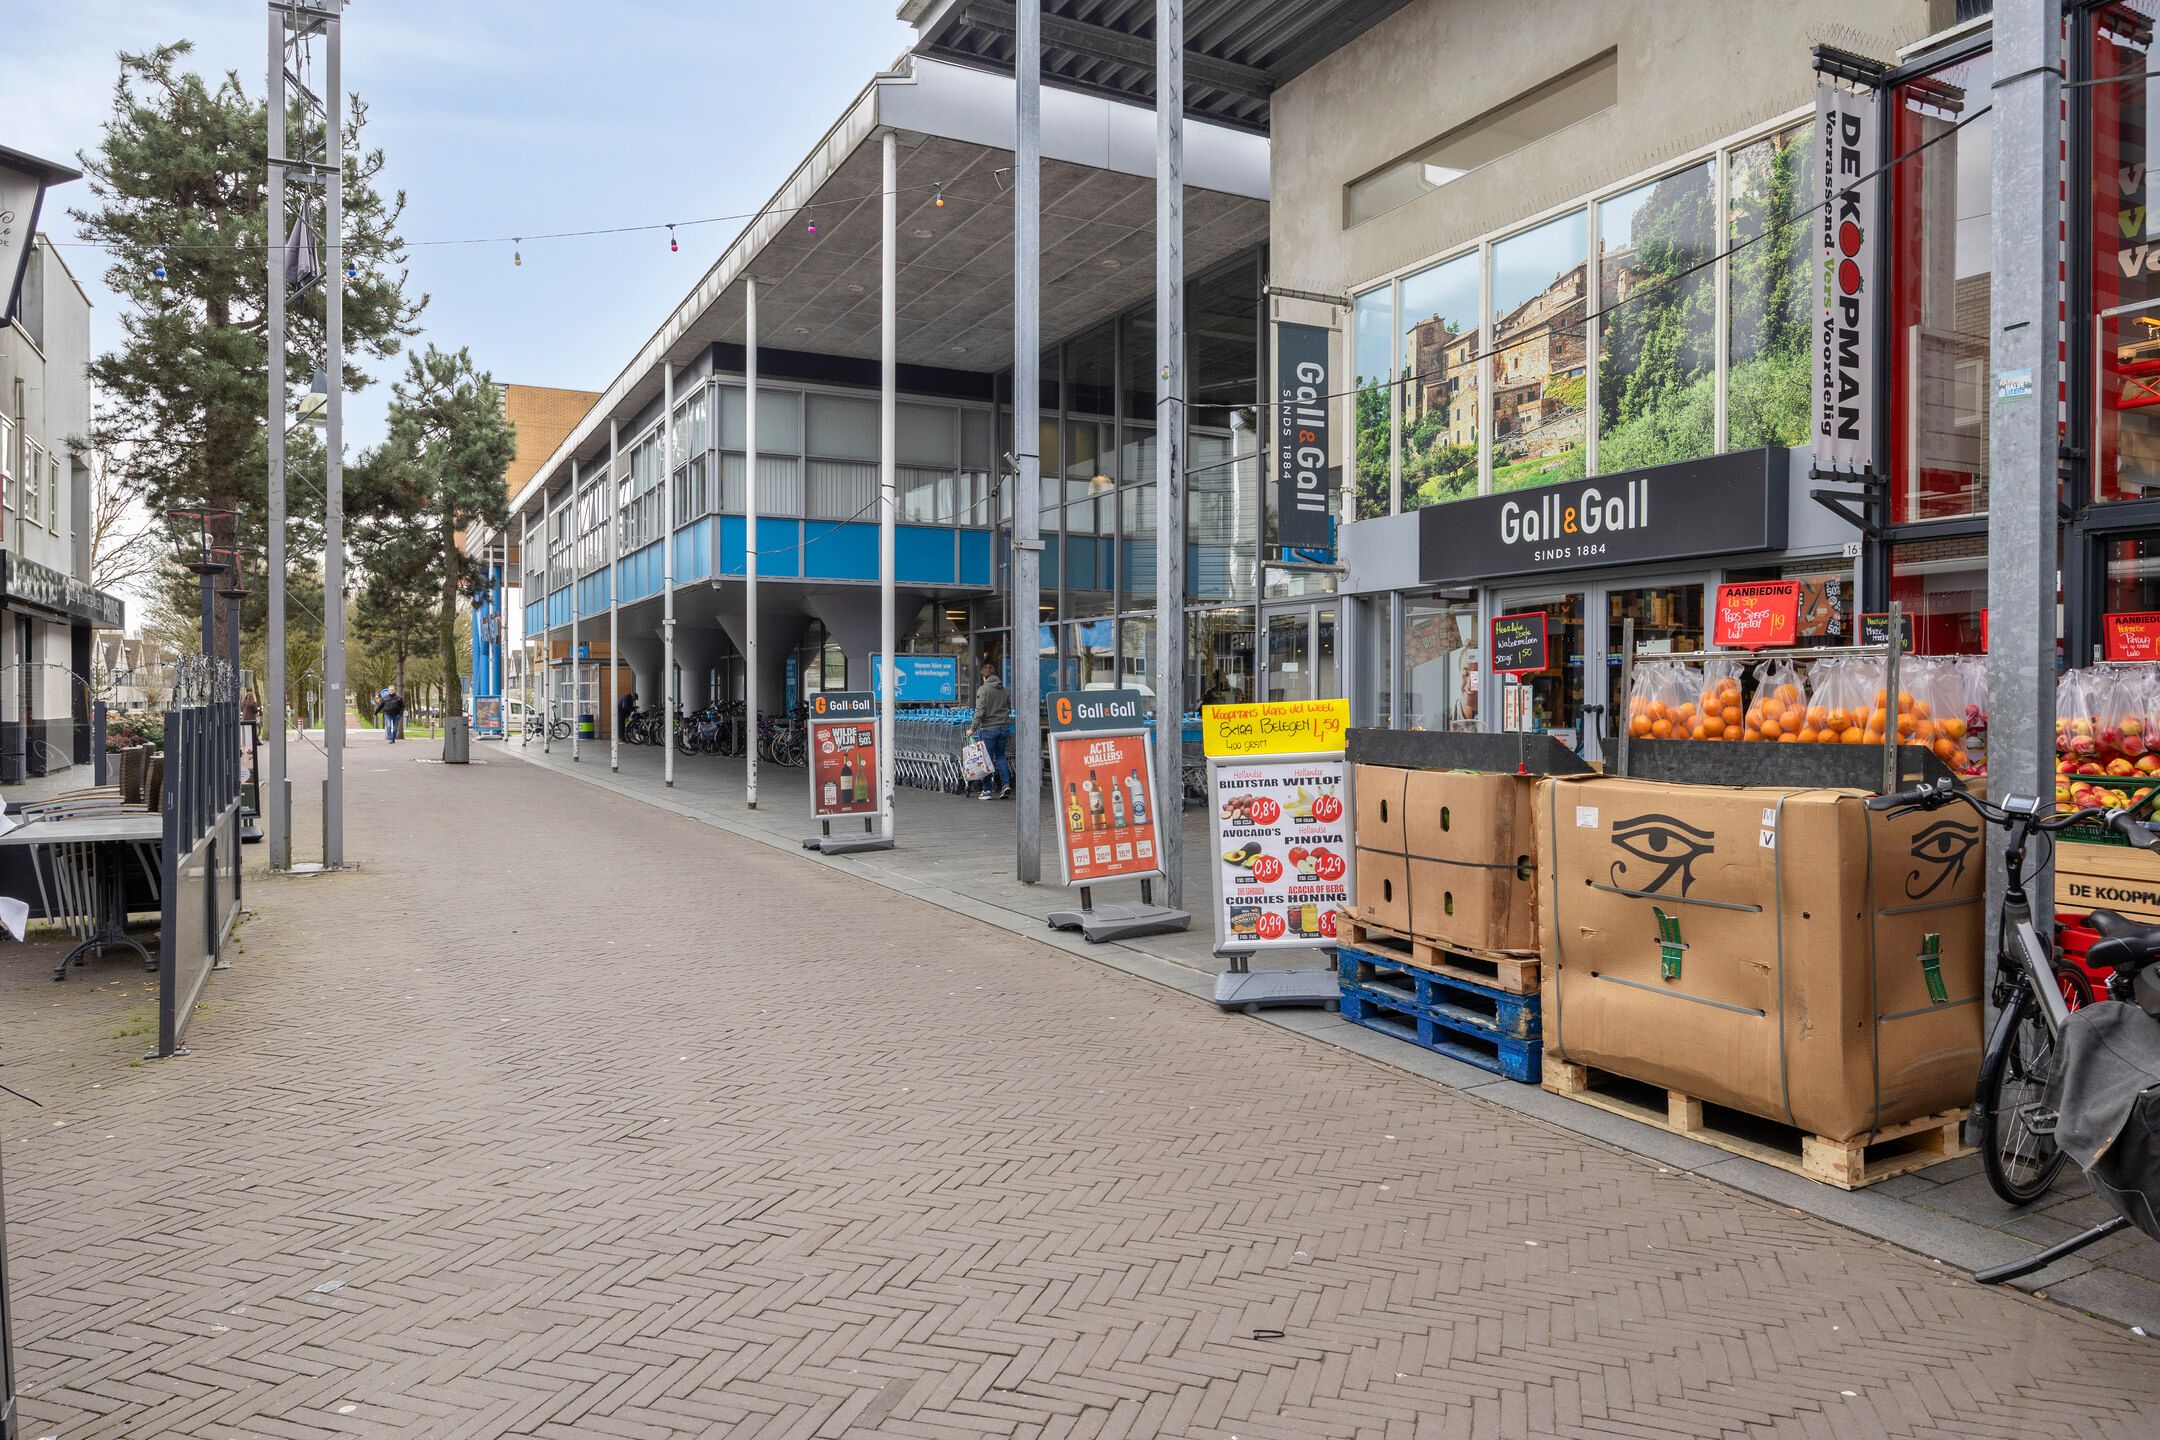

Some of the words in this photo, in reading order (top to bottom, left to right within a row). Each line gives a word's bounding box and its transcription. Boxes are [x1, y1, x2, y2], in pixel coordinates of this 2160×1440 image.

[1841, 111, 1861, 178] DE
[1824, 110, 1837, 249] Verrassend
[1823, 258, 1835, 309] Vers
[1821, 317, 1834, 437] Voordelig
[1283, 389, 1292, 436] SINDS
[1283, 444, 1292, 480] 1884
[1501, 479, 1648, 545] Gall&Gall
[1534, 547, 1571, 561] SINDS
[1577, 543, 1606, 557] 1884
[1847, 544, 1858, 555] 16
[1726, 586, 1793, 597] AANBIEDING
[1077, 701, 1136, 719] Gall&Gall
[832, 727, 857, 737] WILDE
[834, 736, 856, 746] WIJN
[1089, 740, 1116, 755] ACTIE
[1083, 750, 1124, 766] KNALLERS!
[1233, 770, 1262, 779] Hollandse
[1294, 768, 1323, 777] Hollandse
[1219, 779, 1279, 789] BILDTSTAR
[1282, 776, 1341, 786] WITLOF
[1251, 800, 1276, 819] 0,89
[1315, 798, 1338, 816] 0,69
[1222, 828, 1281, 837] AVOCADO'S
[1298, 825, 1327, 834] Hollandse
[1284, 835, 1344, 845] PINOVA
[1763, 832, 1774, 846] V
[1254, 859, 1279, 877] 0,89
[1317, 857, 1341, 874] 1,29
[1288, 886, 1315, 895] ACACIA
[1315, 885, 1325, 894] OF
[1325, 884, 1345, 894] BERG
[2069, 883, 2091, 898] DE
[1225, 895, 1284, 905] COOKIES
[1288, 893, 1347, 903] HONING
[1259, 916, 1282, 933] 0,99
